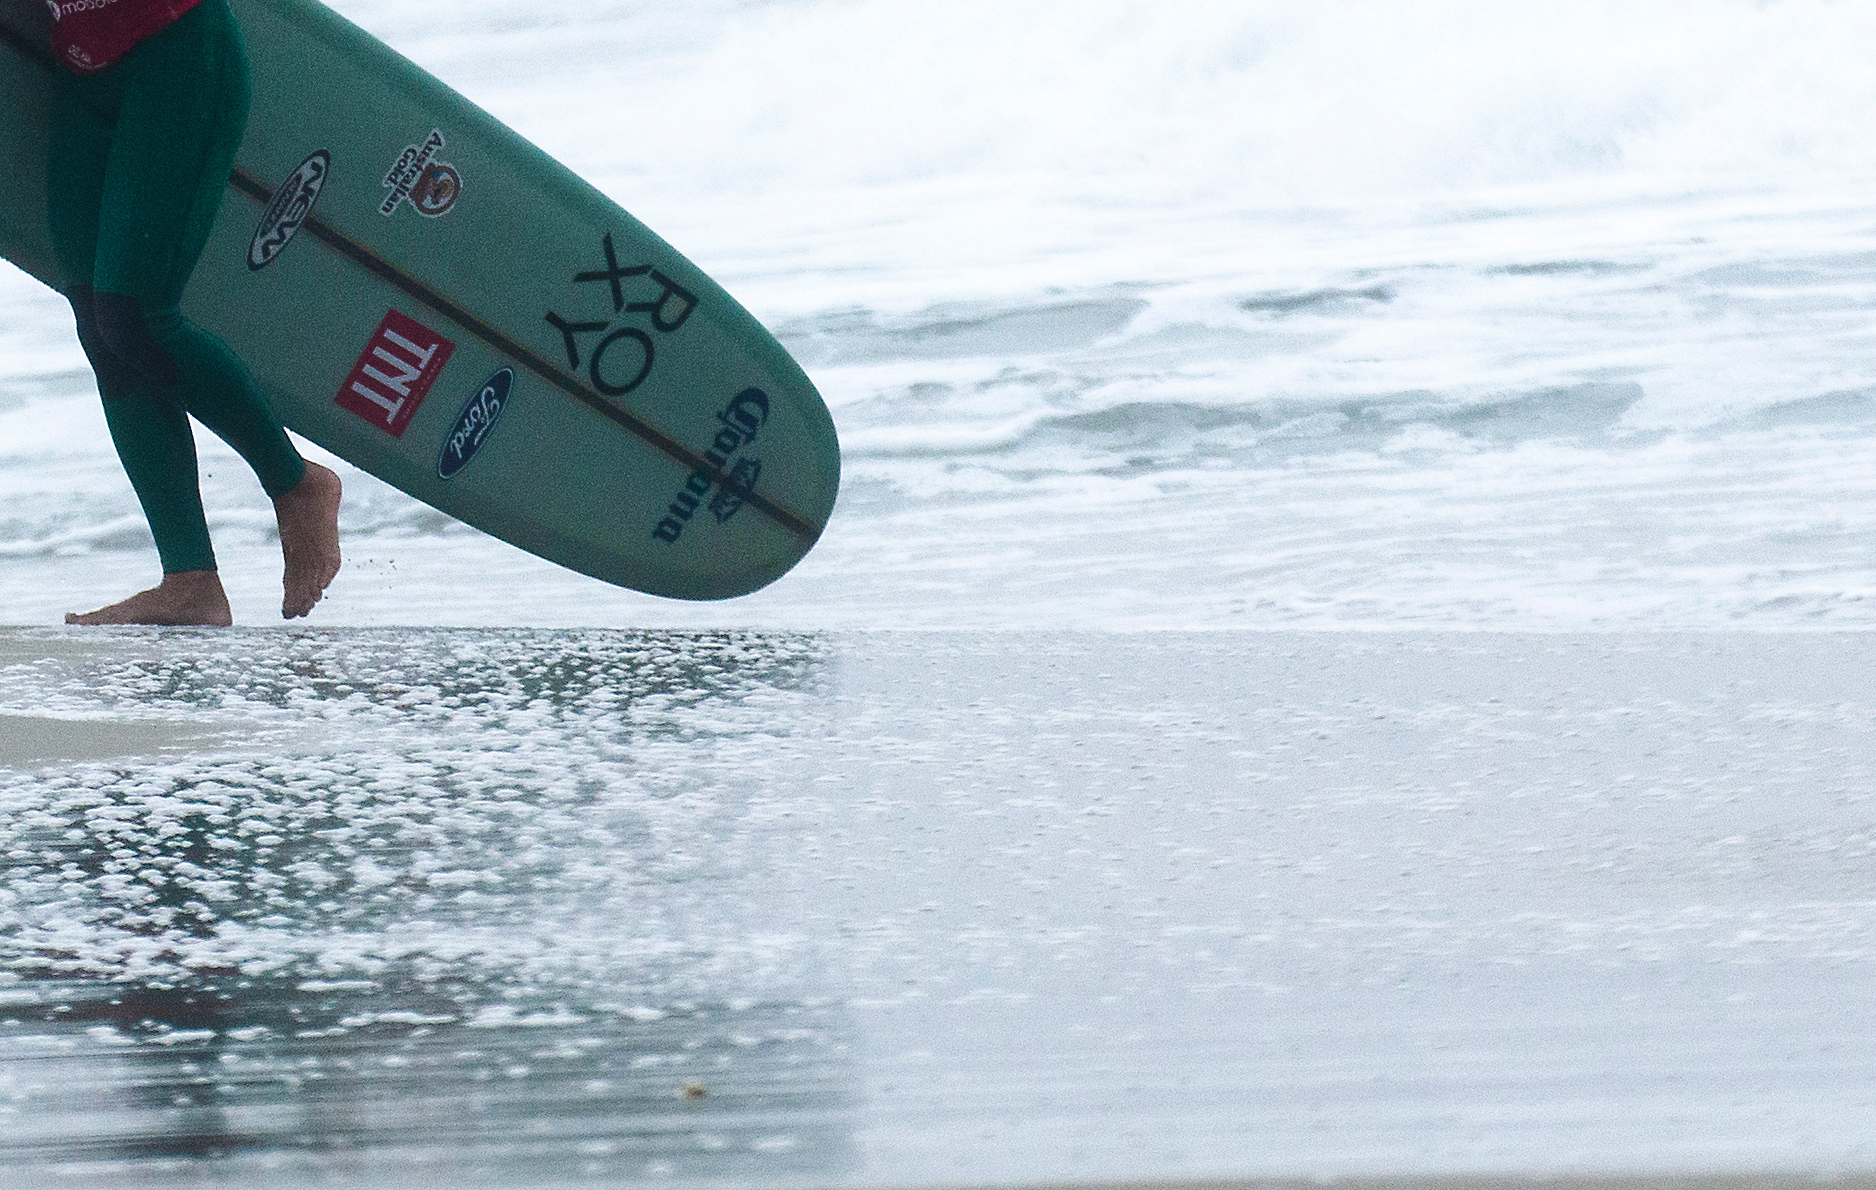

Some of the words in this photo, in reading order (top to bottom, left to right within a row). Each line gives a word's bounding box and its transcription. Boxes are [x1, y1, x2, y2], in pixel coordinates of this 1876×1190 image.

[261, 160, 325, 259] NEW
[381, 131, 442, 214] Australian
[351, 328, 439, 425] TNT
[449, 386, 500, 460] Ford
[652, 387, 770, 543] Corona
